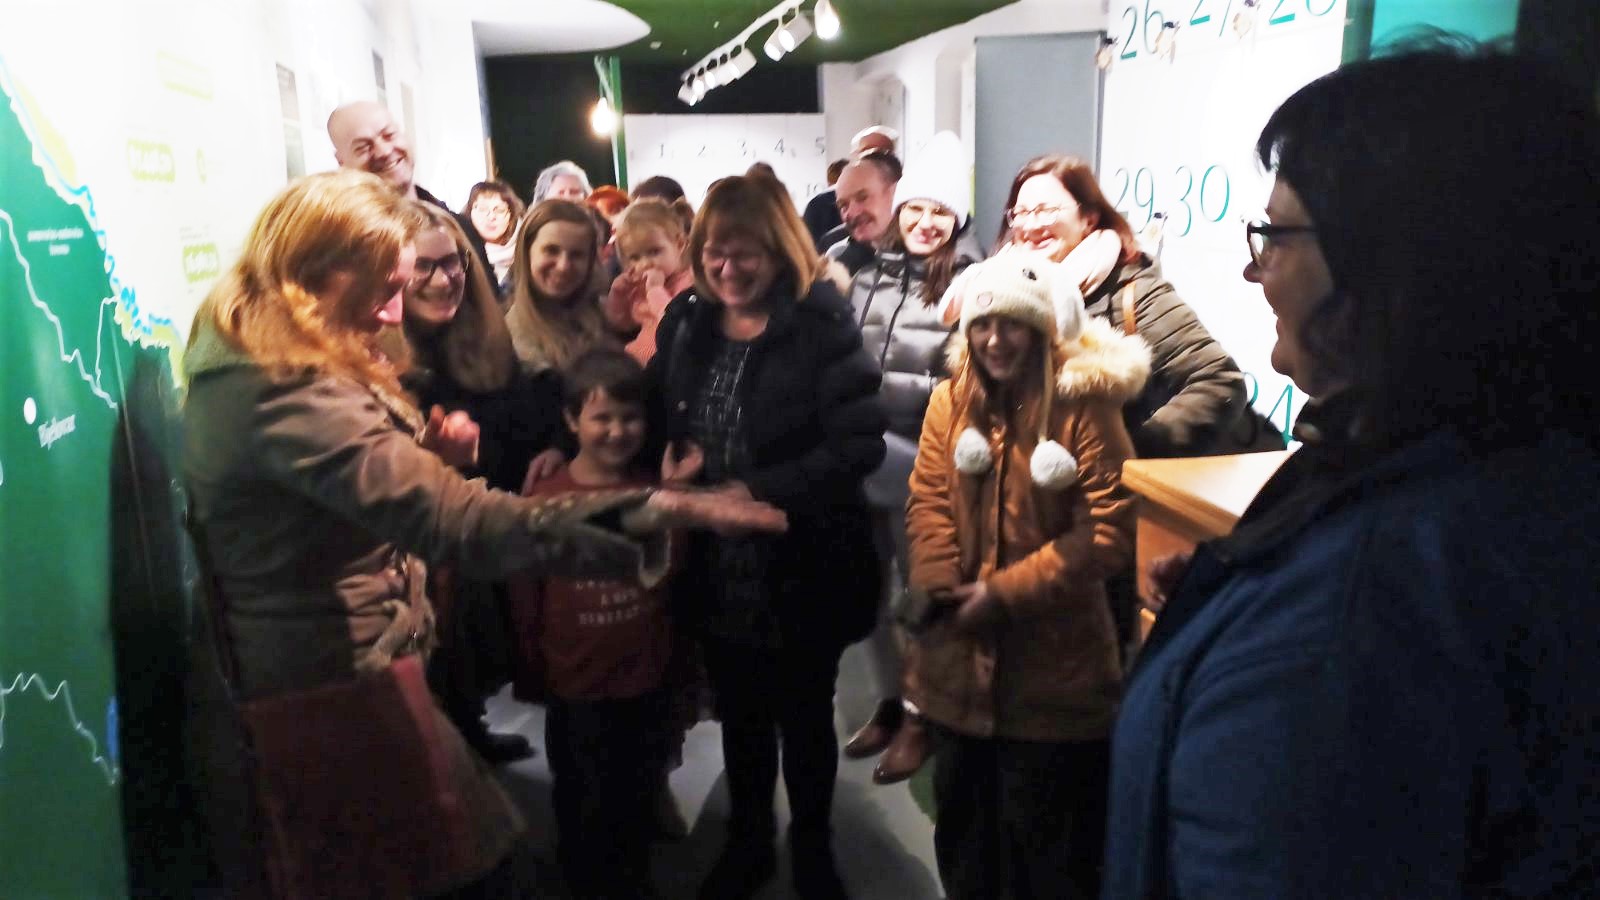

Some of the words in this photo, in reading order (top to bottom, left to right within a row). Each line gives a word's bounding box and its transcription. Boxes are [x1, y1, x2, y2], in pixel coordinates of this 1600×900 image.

[1120, 0, 1164, 60] 26
[774, 137, 785, 157] 4
[815, 136, 826, 155] 5
[1114, 166, 1154, 235] 29
[1174, 163, 1230, 238] 30
